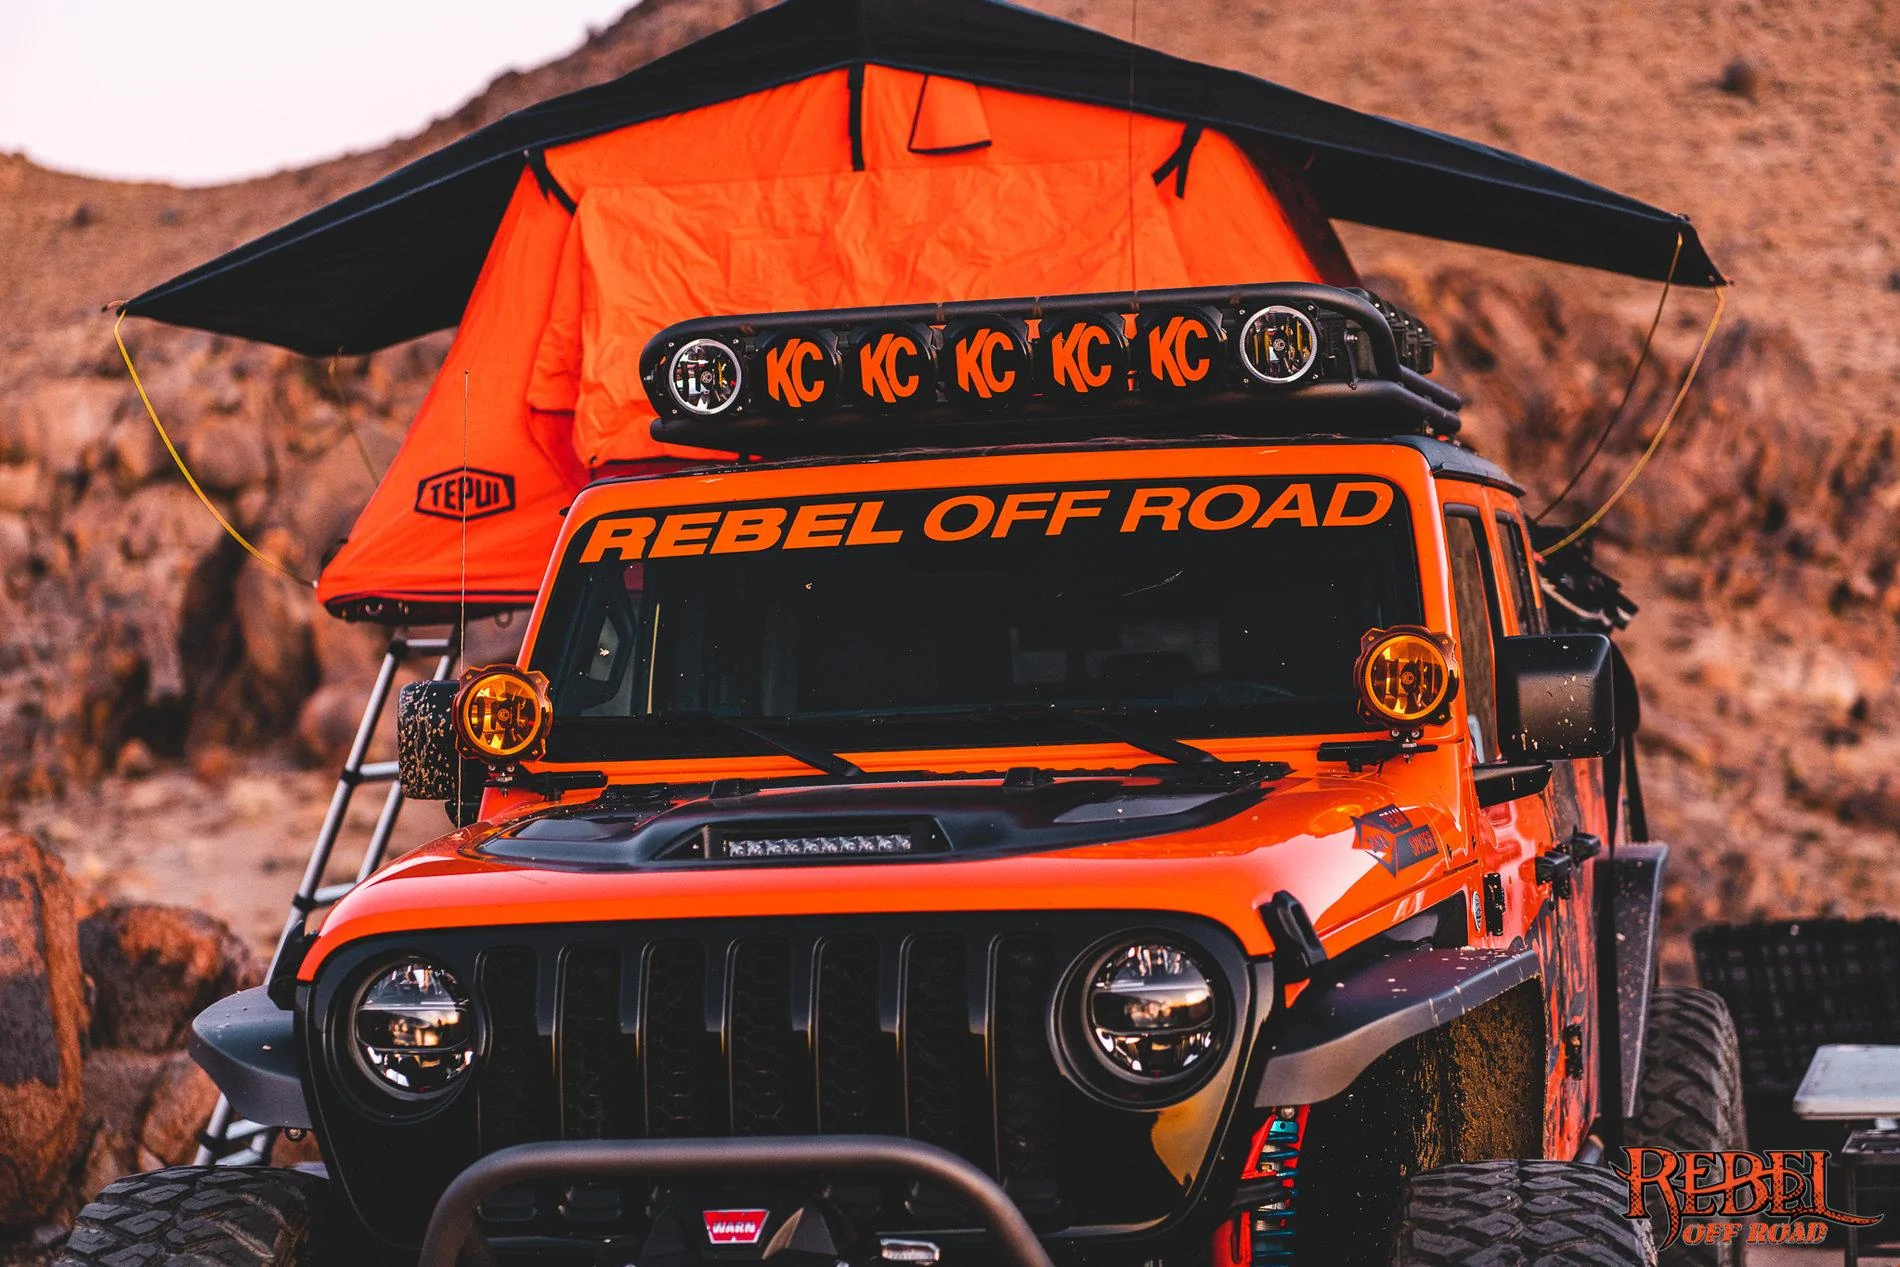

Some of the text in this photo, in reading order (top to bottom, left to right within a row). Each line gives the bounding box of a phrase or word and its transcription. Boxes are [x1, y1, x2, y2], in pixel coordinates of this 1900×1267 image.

[767, 339, 824, 407] KC
[860, 334, 919, 402] KC
[956, 329, 1015, 398] KC
[1052, 323, 1111, 392] KC
[1149, 317, 1209, 386] KC
[431, 476, 499, 512] TEPUI
[580, 482, 1394, 563] REBEL OFF ROAD
[1408, 831, 1436, 856] SPICER
[713, 1222, 756, 1233] WARN
